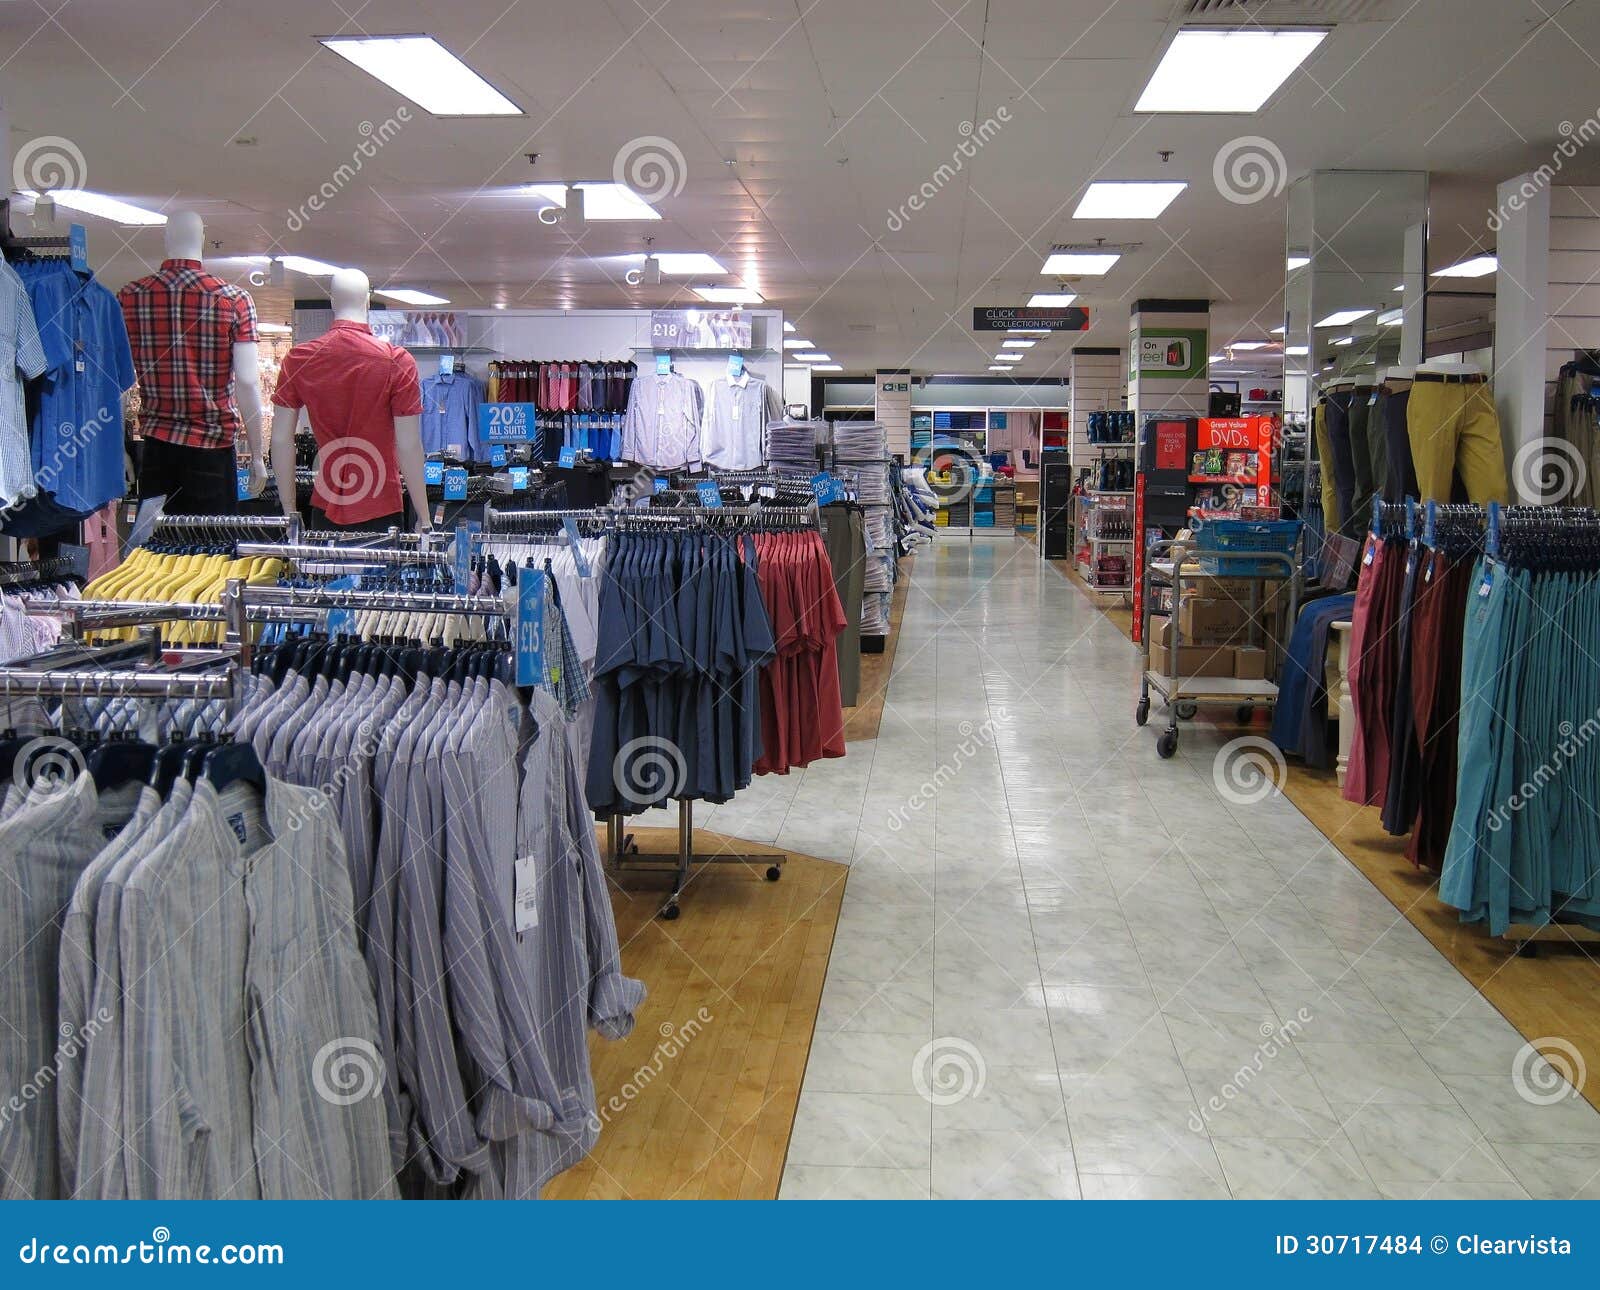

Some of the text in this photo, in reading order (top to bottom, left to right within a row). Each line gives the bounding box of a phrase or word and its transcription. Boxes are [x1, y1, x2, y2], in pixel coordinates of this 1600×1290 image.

[986, 309, 1015, 318] CLICK
[992, 320, 1064, 328] COLLECTION POINT
[653, 323, 677, 337] £18
[489, 405, 526, 426] 20%
[489, 425, 527, 436] ALL SUITS
[1210, 421, 1247, 429] Great Value
[1210, 429, 1250, 447] DVDs
[447, 475, 467, 485] 20%
[813, 479, 832, 492] 20%
[448, 484, 461, 492] OFF
[700, 488, 718, 498] 20%
[818, 487, 830, 498] OFF
[521, 621, 540, 653] £15
